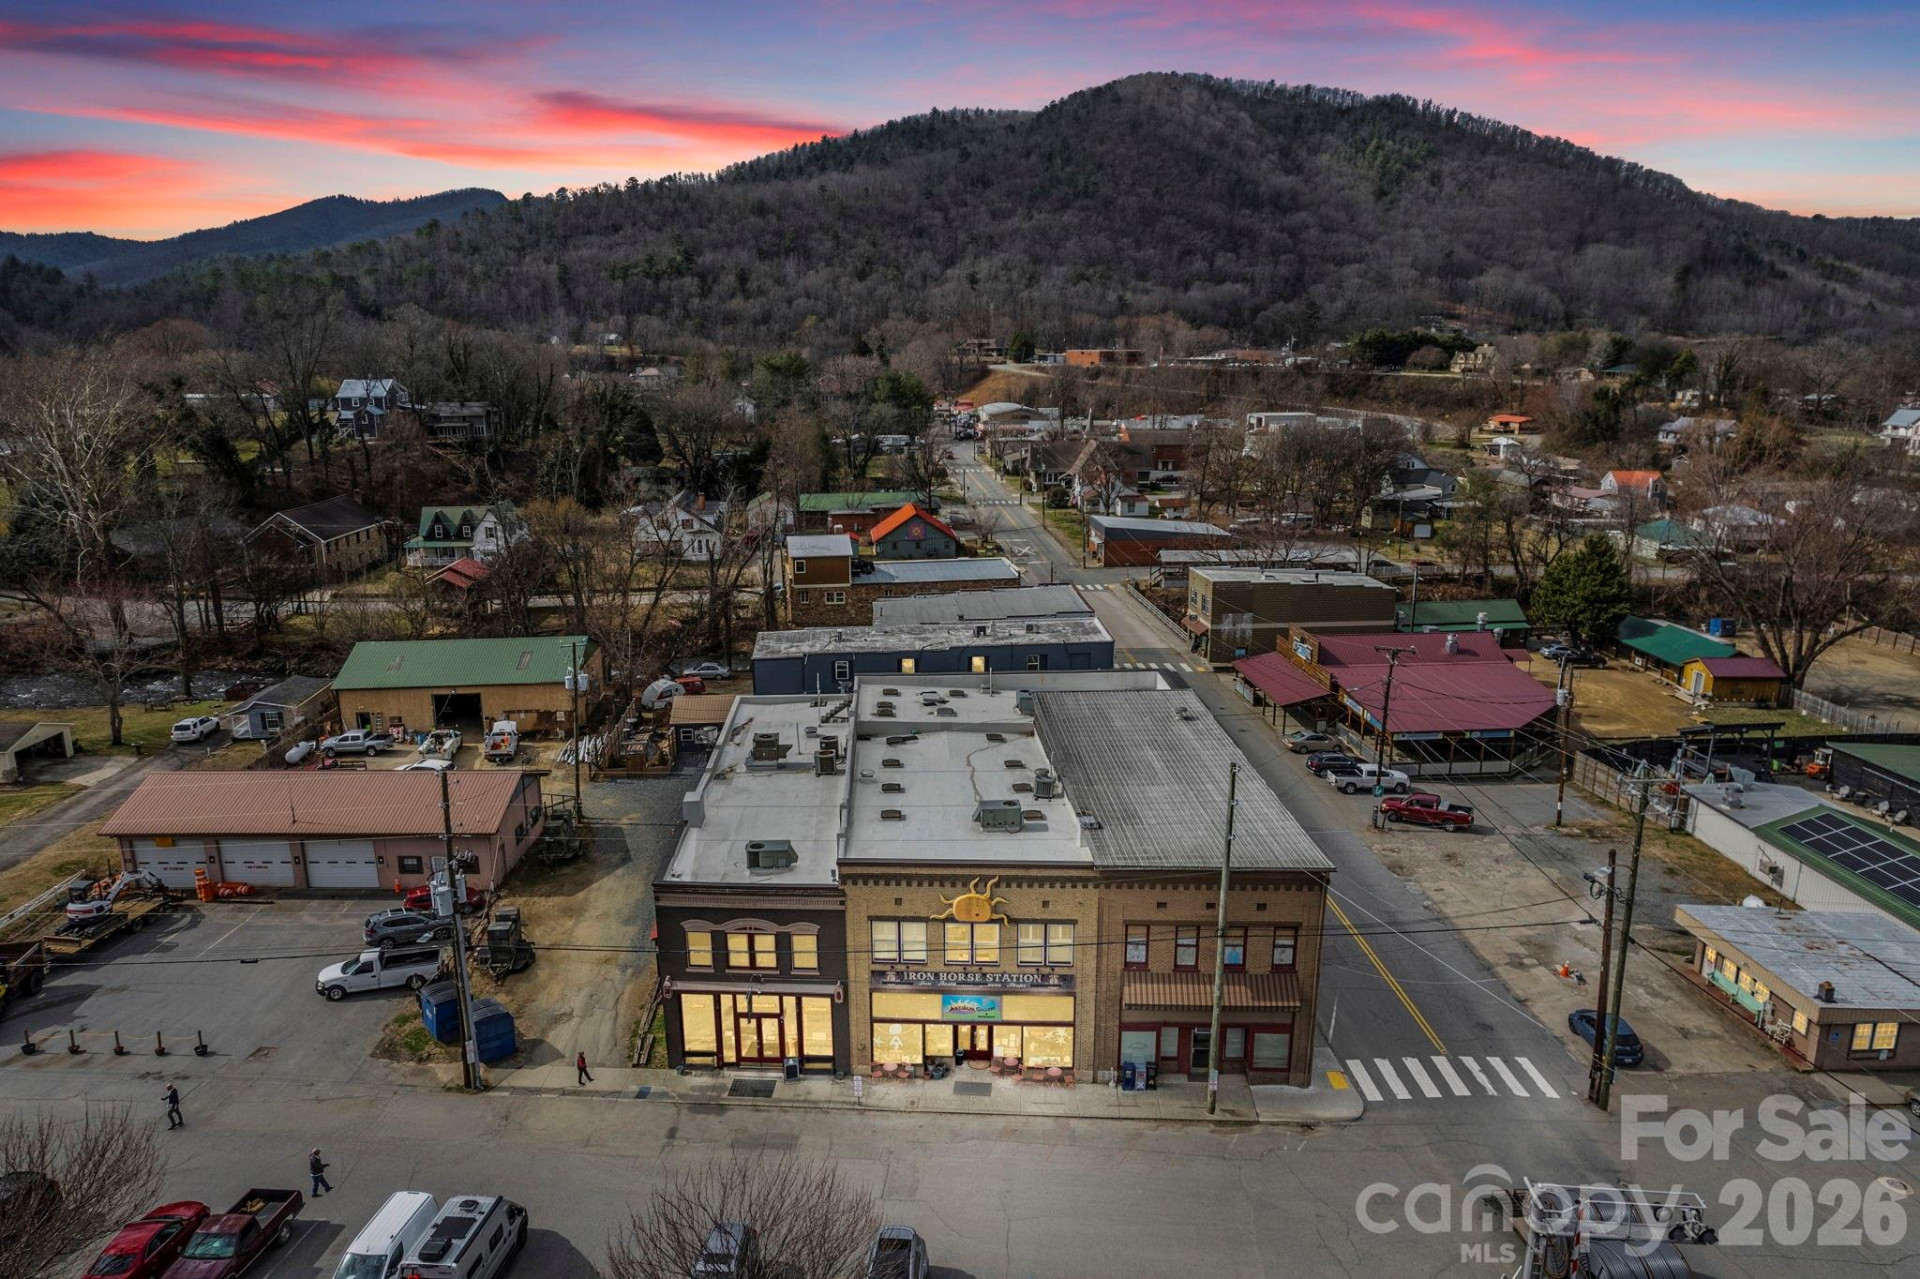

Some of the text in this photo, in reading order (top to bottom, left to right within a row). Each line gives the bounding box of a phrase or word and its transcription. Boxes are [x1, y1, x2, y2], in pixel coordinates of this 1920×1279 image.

[903, 971, 1042, 983] IRON HORSE STATION
